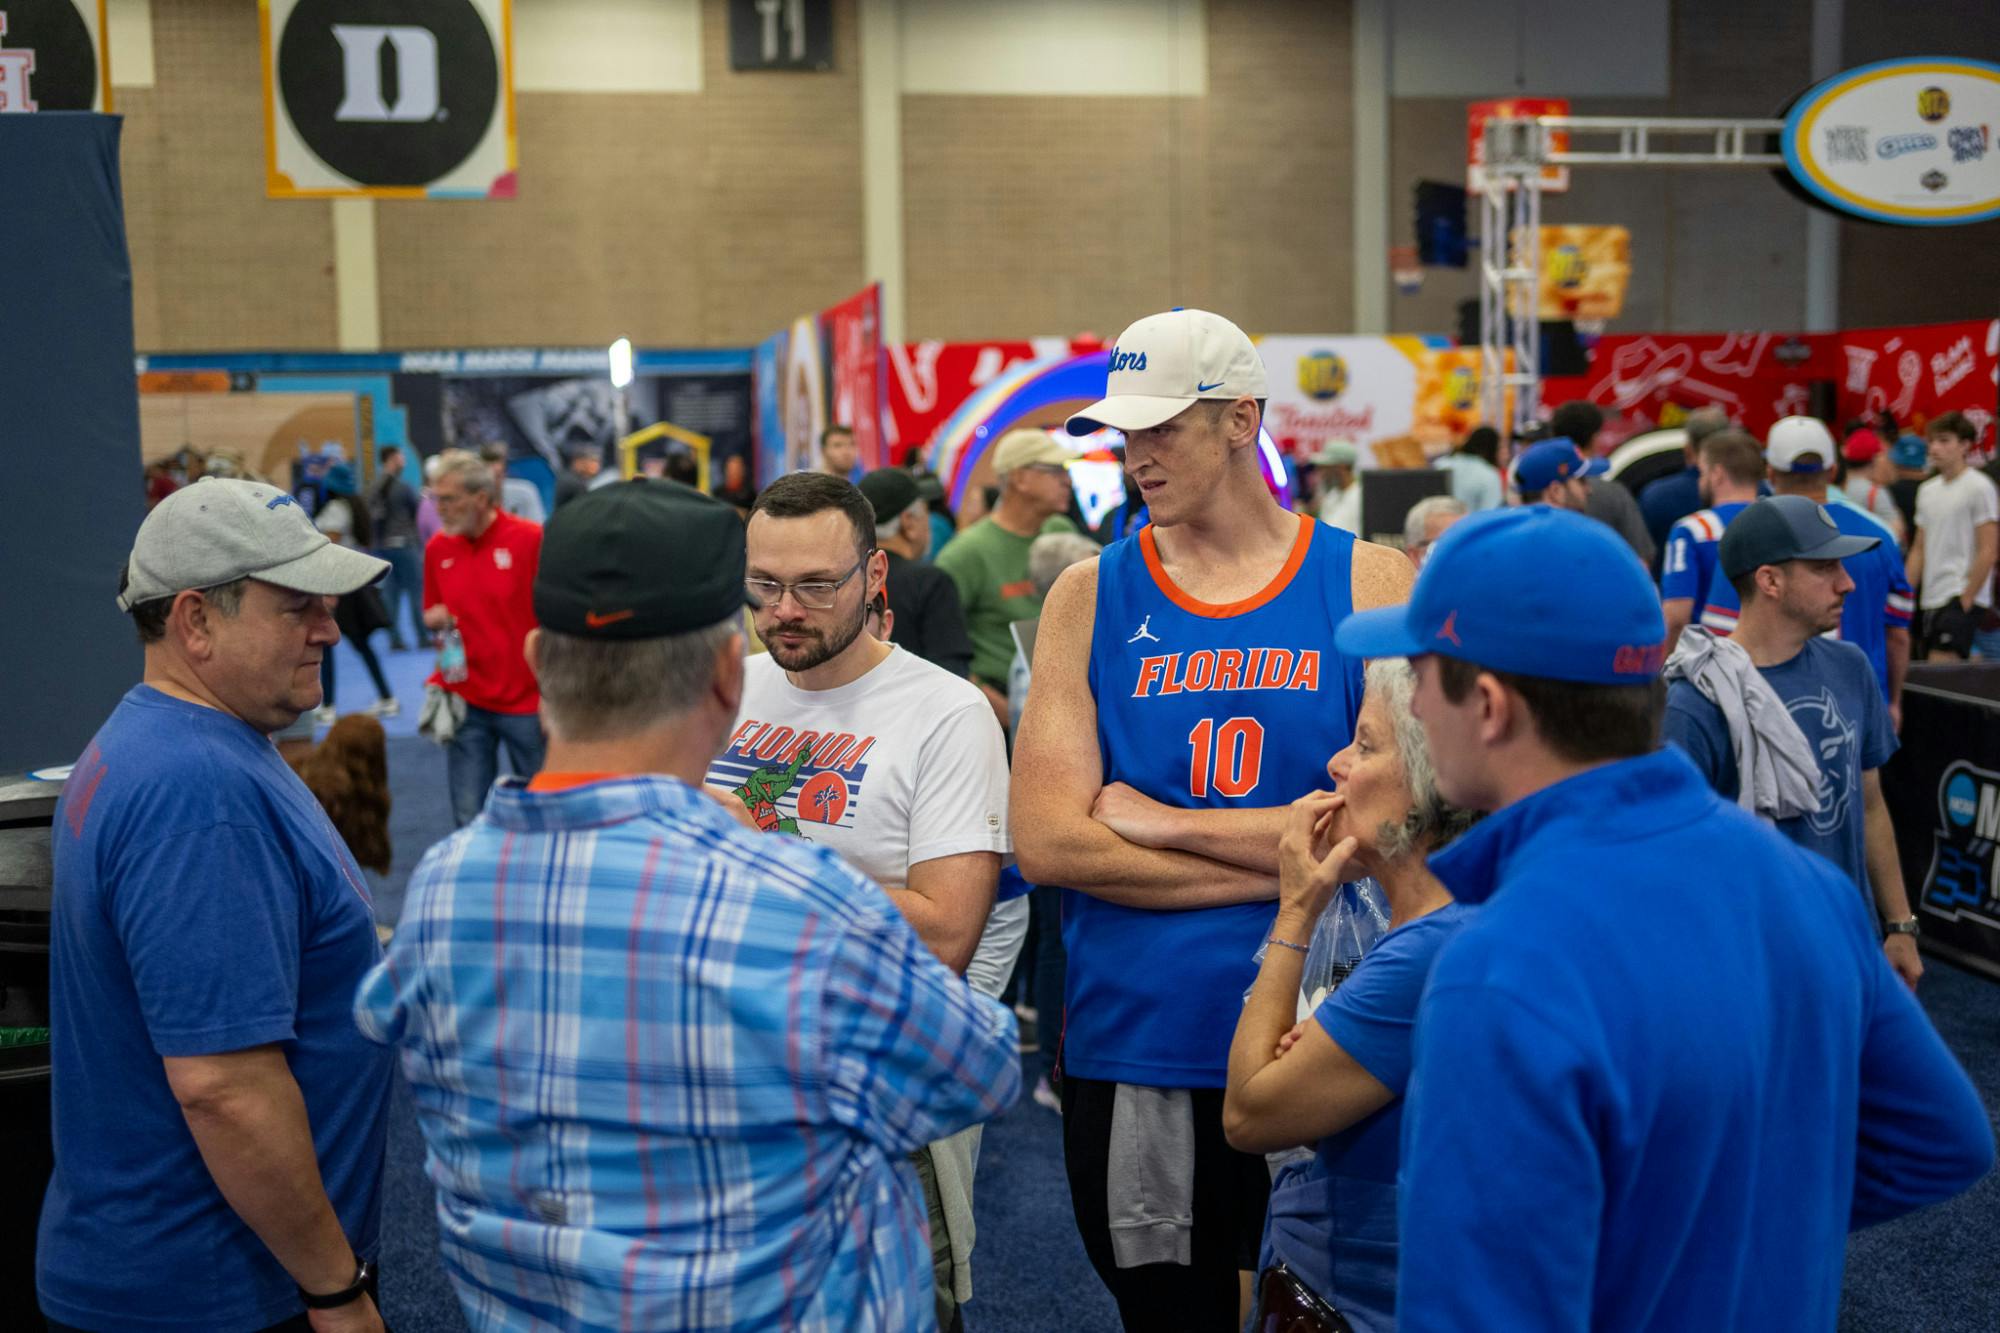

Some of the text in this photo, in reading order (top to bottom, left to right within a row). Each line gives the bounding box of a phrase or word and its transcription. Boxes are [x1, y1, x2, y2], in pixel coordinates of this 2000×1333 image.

[330, 24, 440, 121] D
[1131, 648, 1320, 697] FLORIDA
[726, 719, 878, 771] FLORIDA
[1188, 716, 1264, 797] 10
